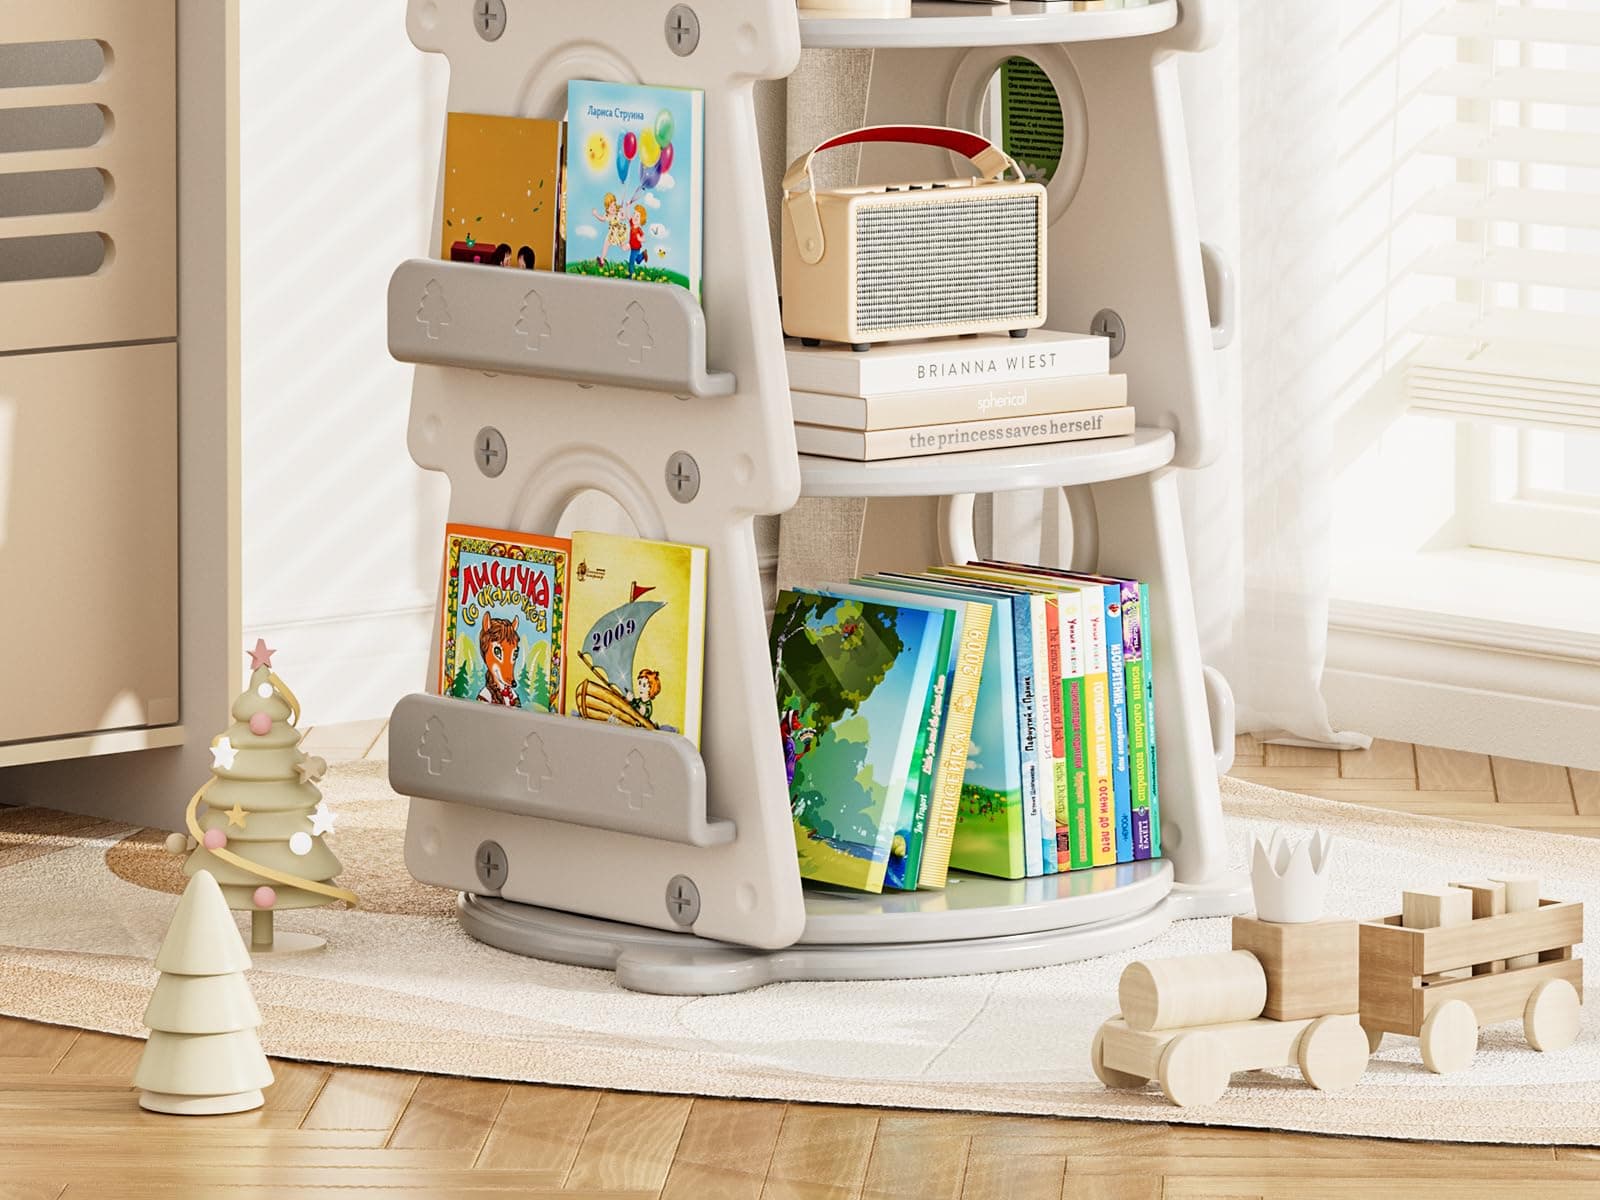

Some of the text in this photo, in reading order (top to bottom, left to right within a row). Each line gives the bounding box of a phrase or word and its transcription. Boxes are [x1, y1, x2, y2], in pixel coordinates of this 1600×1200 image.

[588, 104, 613, 119] Лариса
[917, 353, 1057, 379] BRIANNA WIEST
[976, 389, 1028, 413] spherical
[909, 415, 1104, 450] the princess saves herself
[592, 619, 636, 651] 2009
[1049, 628, 1064, 742] The Famous Adventures of Jack
[936, 629, 984, 838] ЕНИСЕЙКА 2009
